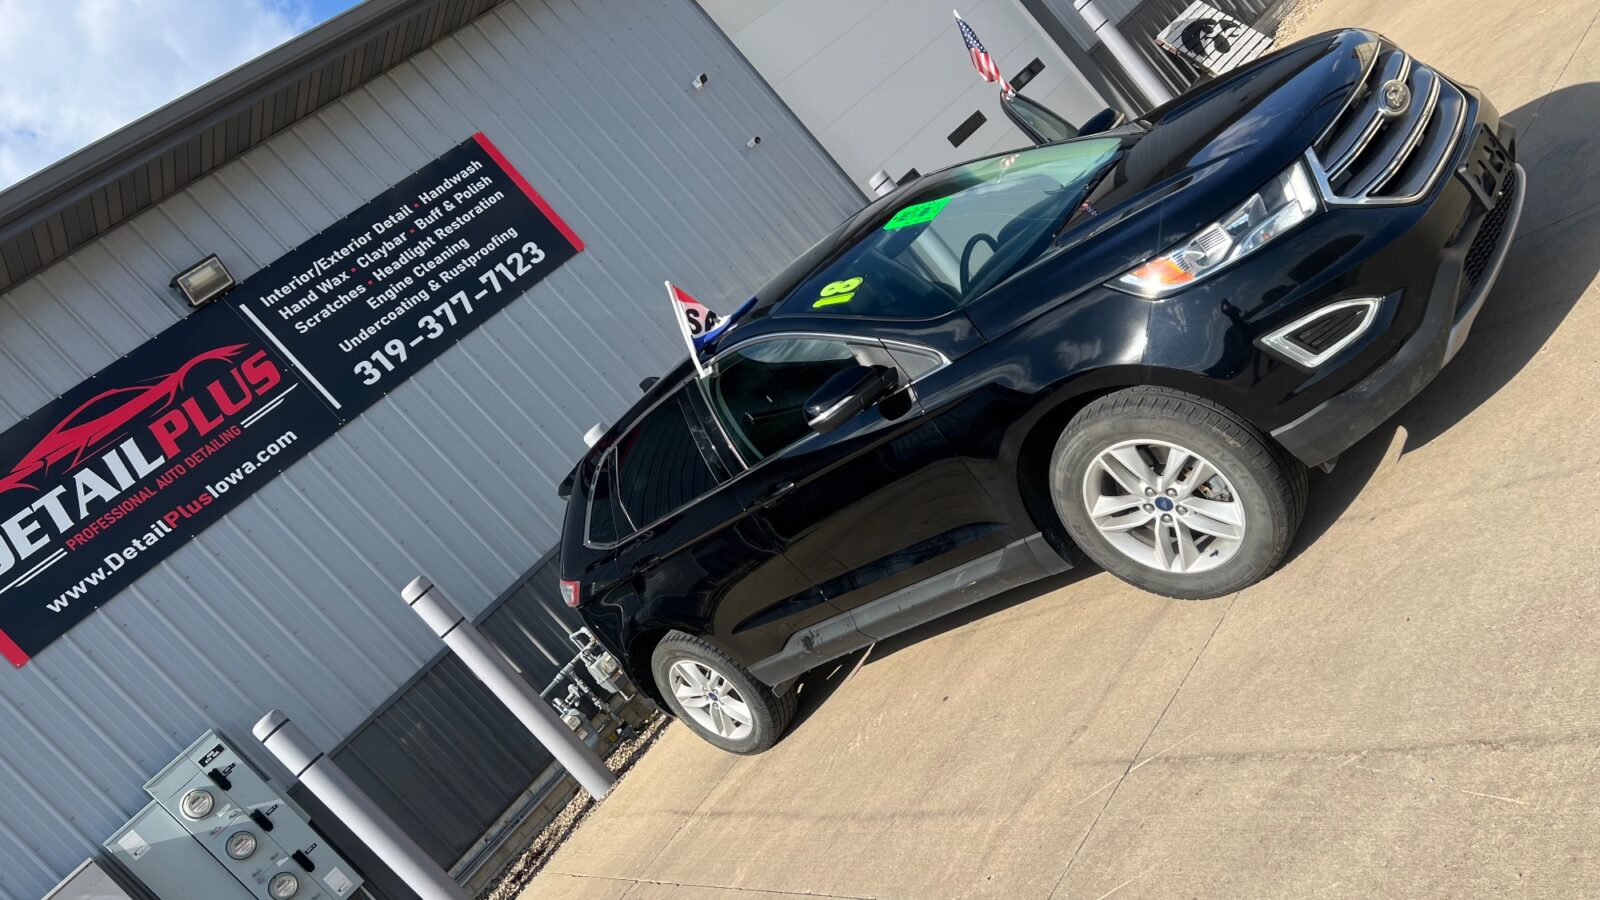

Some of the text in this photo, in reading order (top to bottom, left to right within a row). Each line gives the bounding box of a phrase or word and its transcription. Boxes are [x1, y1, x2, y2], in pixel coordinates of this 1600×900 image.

[259, 160, 482, 307] Interior/Exterior Detail Handwash
[277, 176, 492, 319] Hand Wax Claybar Buff & Polish
[294, 191, 504, 333] Scratches Headlight Restoration
[338, 227, 518, 352] Undercoating & Rustproofing
[366, 238, 470, 309] Engine Cleaning
[353, 241, 545, 385] 319-377-7123
[685, 308, 721, 335] SA
[0, 437, 165, 574] ETAIL
[45, 430, 297, 612] www.DetailPlusIowa.com
[65, 425, 241, 550] PROFESSIONAL AUTO DETAILING
